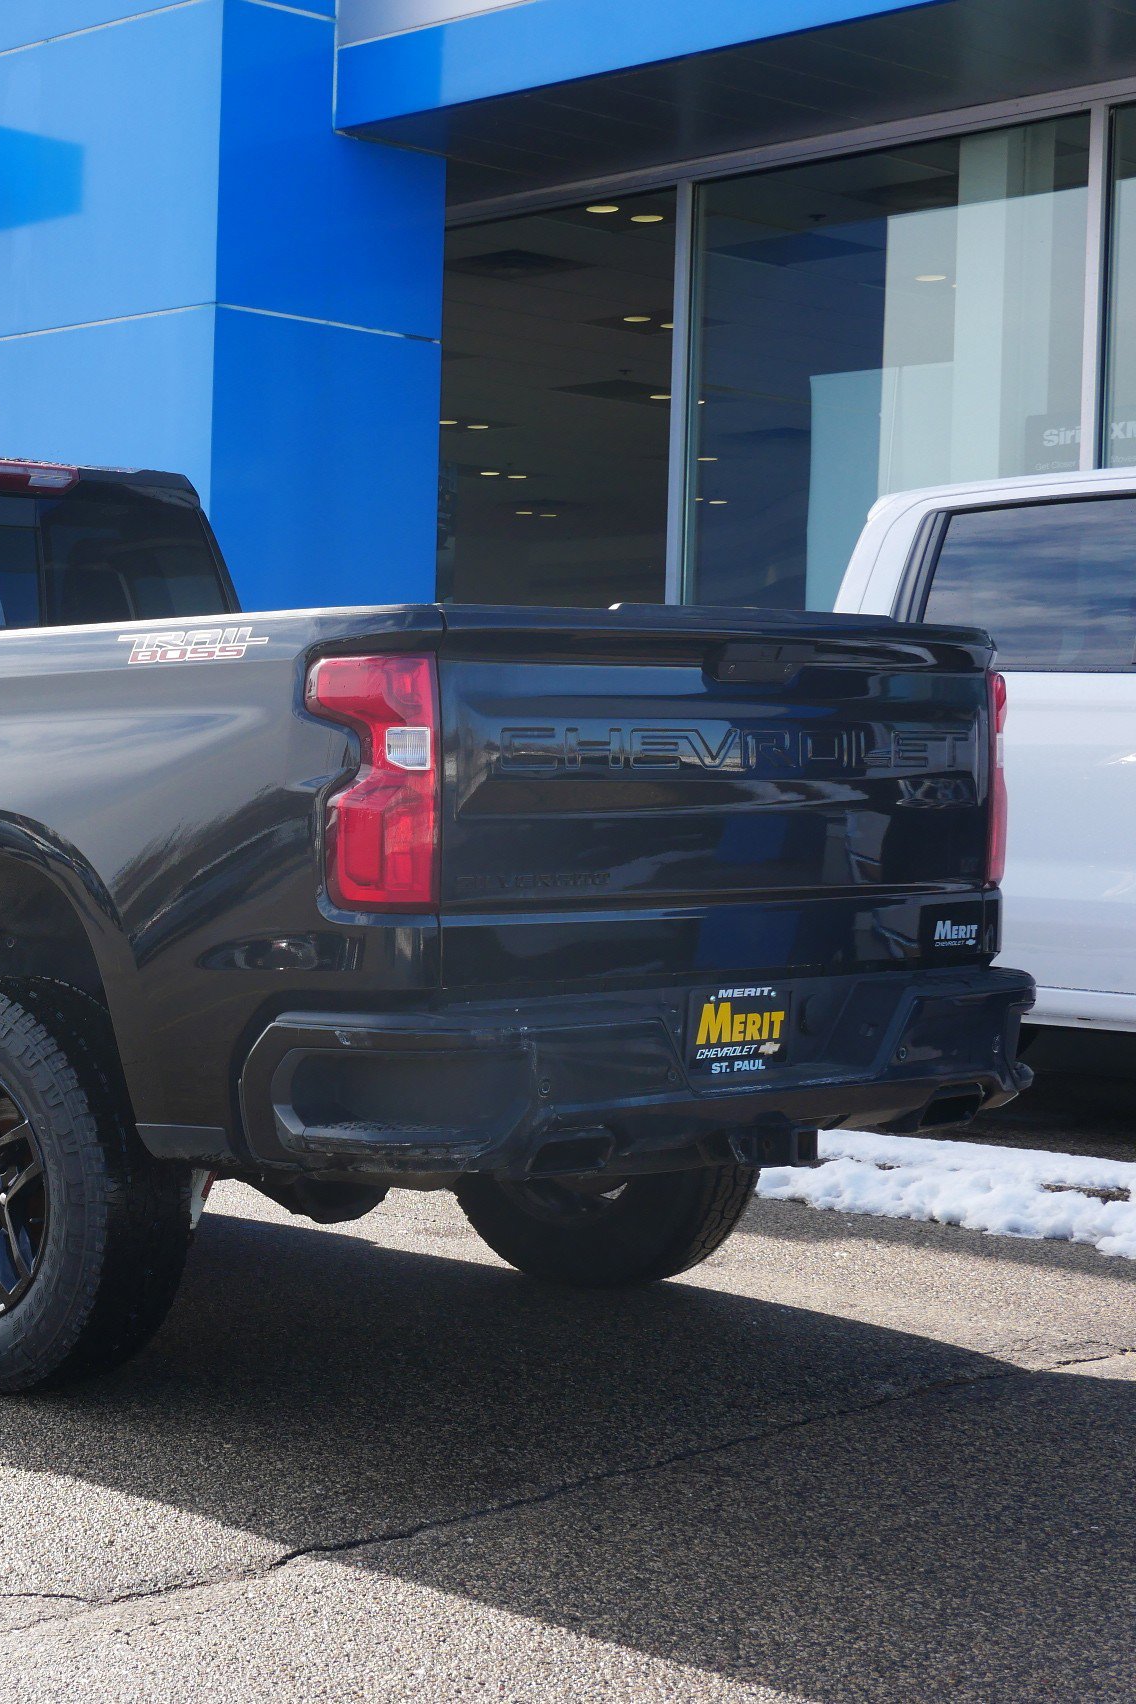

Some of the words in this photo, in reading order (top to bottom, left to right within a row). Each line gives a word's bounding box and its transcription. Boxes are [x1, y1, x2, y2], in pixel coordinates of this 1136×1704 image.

[117, 626, 269, 650] TRAIL
[128, 644, 247, 665] BOSS
[500, 726, 970, 771] CHEVROLET
[717, 986, 772, 998] MERIT
[695, 1044, 758, 1060] CHEVROLET
[711, 1061, 730, 1074] ST.
[733, 1059, 766, 1072] PAUL
